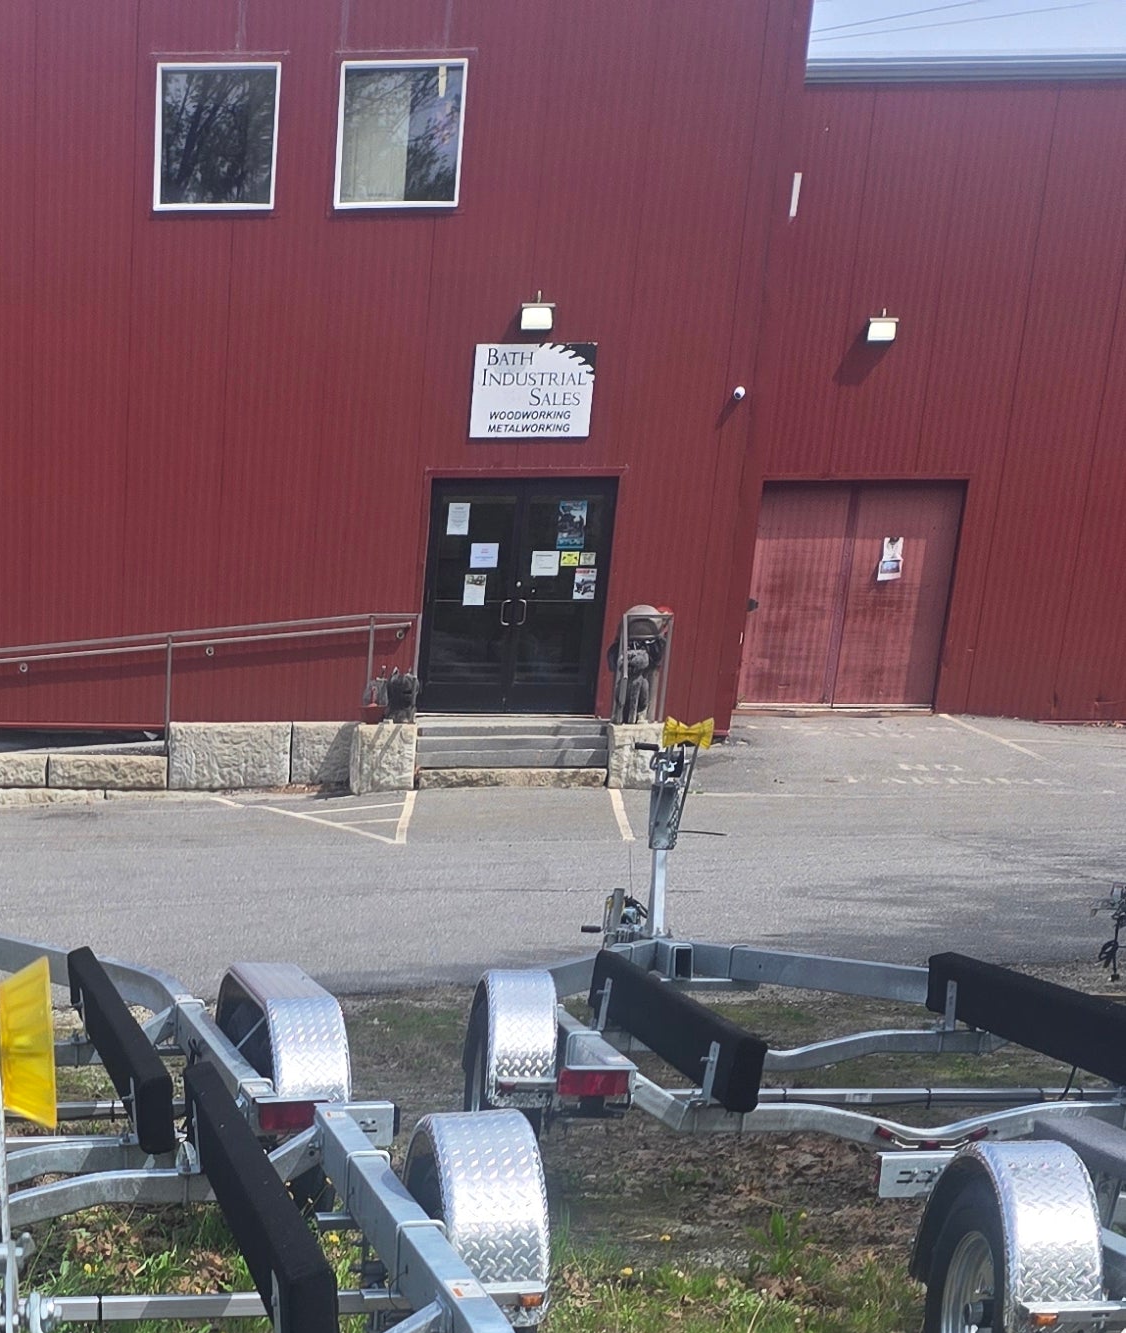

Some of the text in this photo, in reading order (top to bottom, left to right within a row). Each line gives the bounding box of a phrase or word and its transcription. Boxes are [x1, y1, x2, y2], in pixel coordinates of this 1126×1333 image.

[487, 348, 534, 366] BATH
[482, 368, 587, 387] INDUSTRIAL
[529, 387, 581, 407] SALES
[489, 410, 571, 420] WOODWORKING
[487, 423, 570, 433] METALWORKING
